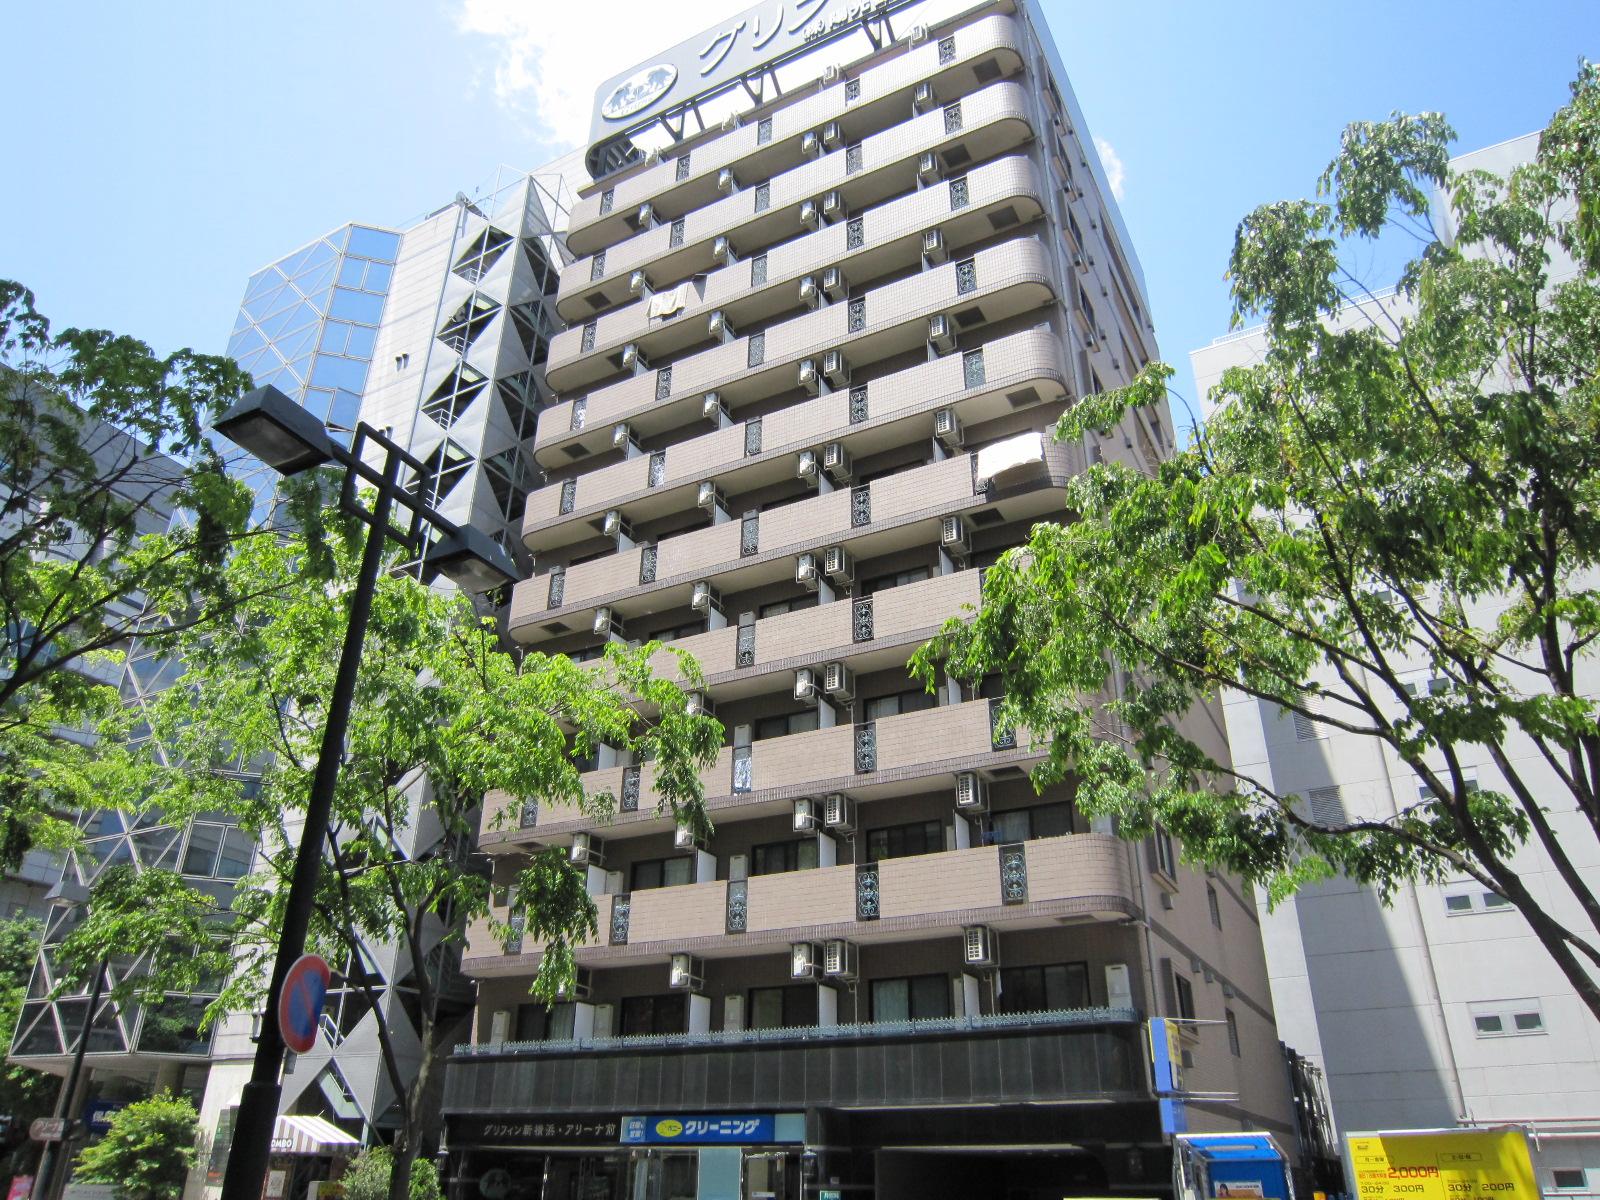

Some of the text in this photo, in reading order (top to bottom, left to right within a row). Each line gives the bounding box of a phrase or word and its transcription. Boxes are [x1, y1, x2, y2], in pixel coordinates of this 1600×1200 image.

[685, 1119, 760, 1135] クリーニング
[1388, 1166, 1439, 1180] 2,000円
[1361, 1184, 1425, 1194] 30分 300円
[1447, 1182, 1515, 1192] 30分 200円
